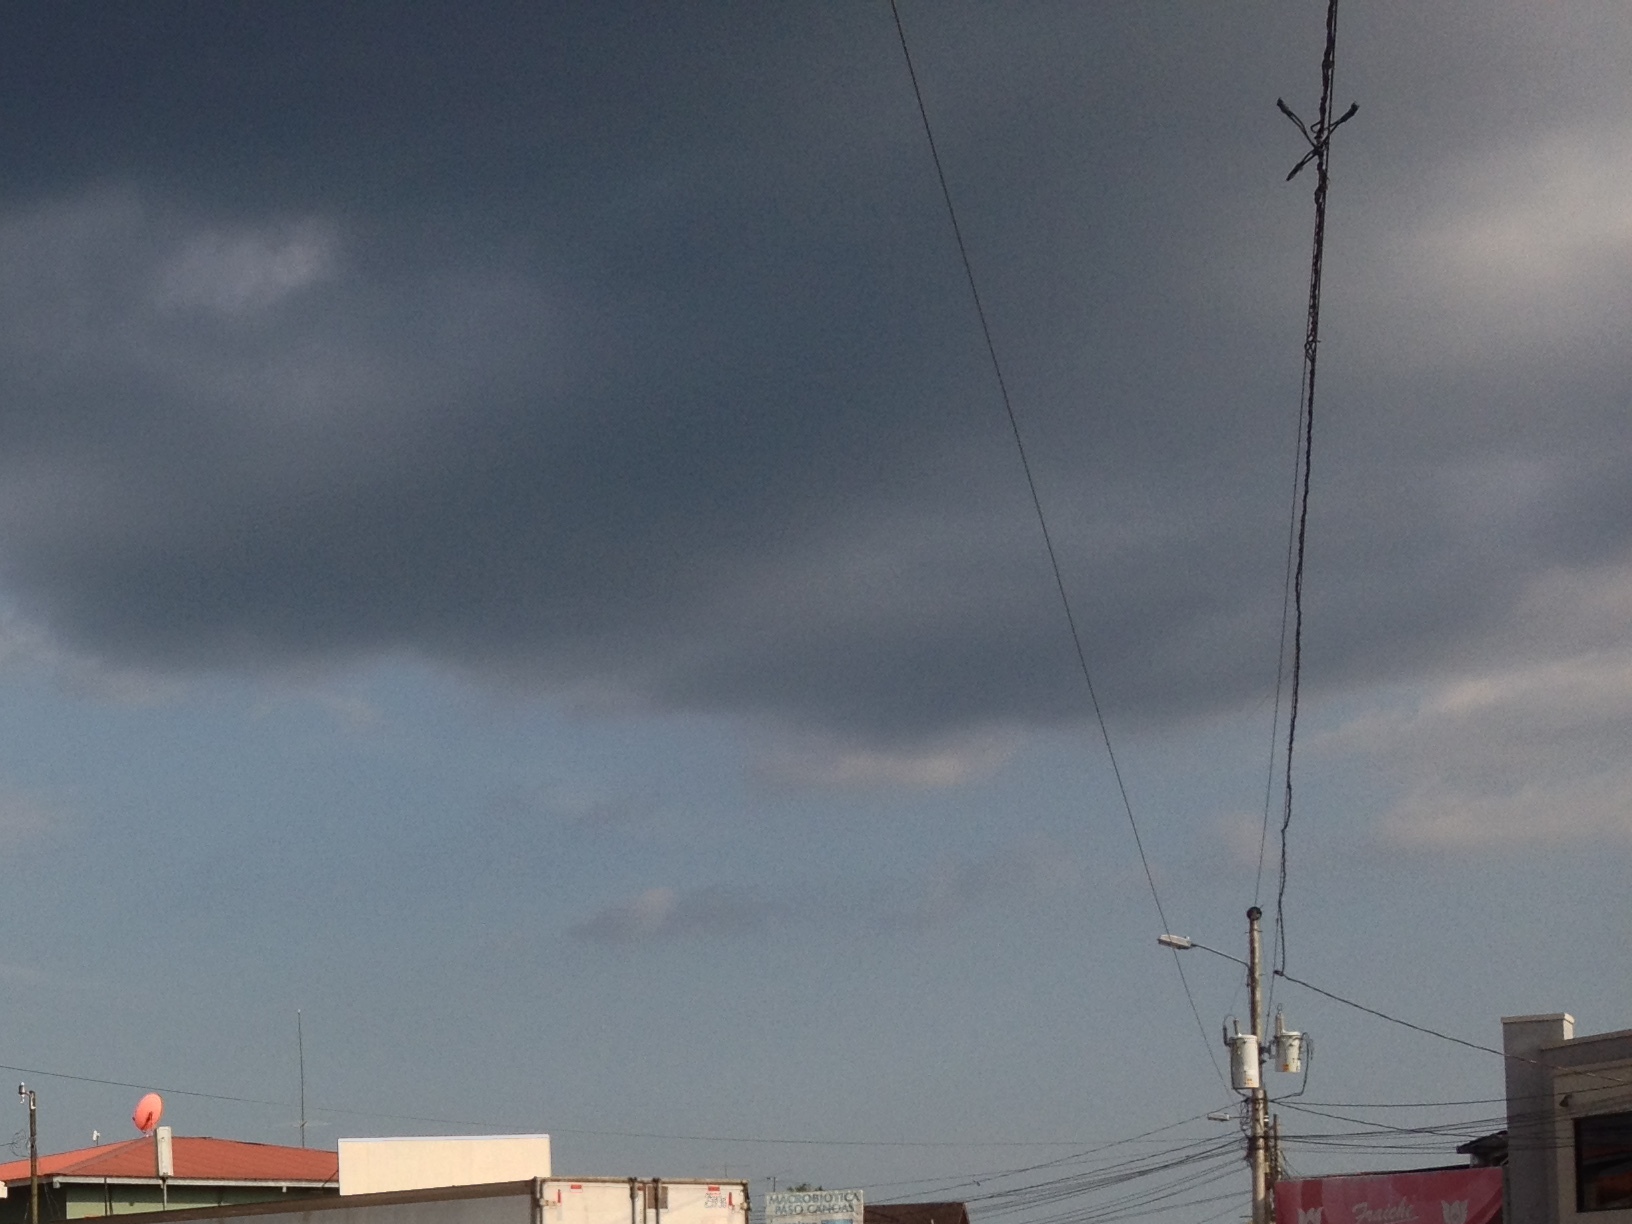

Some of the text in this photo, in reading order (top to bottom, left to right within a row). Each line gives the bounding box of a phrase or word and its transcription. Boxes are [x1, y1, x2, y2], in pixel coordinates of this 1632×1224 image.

[770, 1191, 860, 1204] MACROBIOTICA
[775, 1203, 855, 1216] PASO CANOAS
